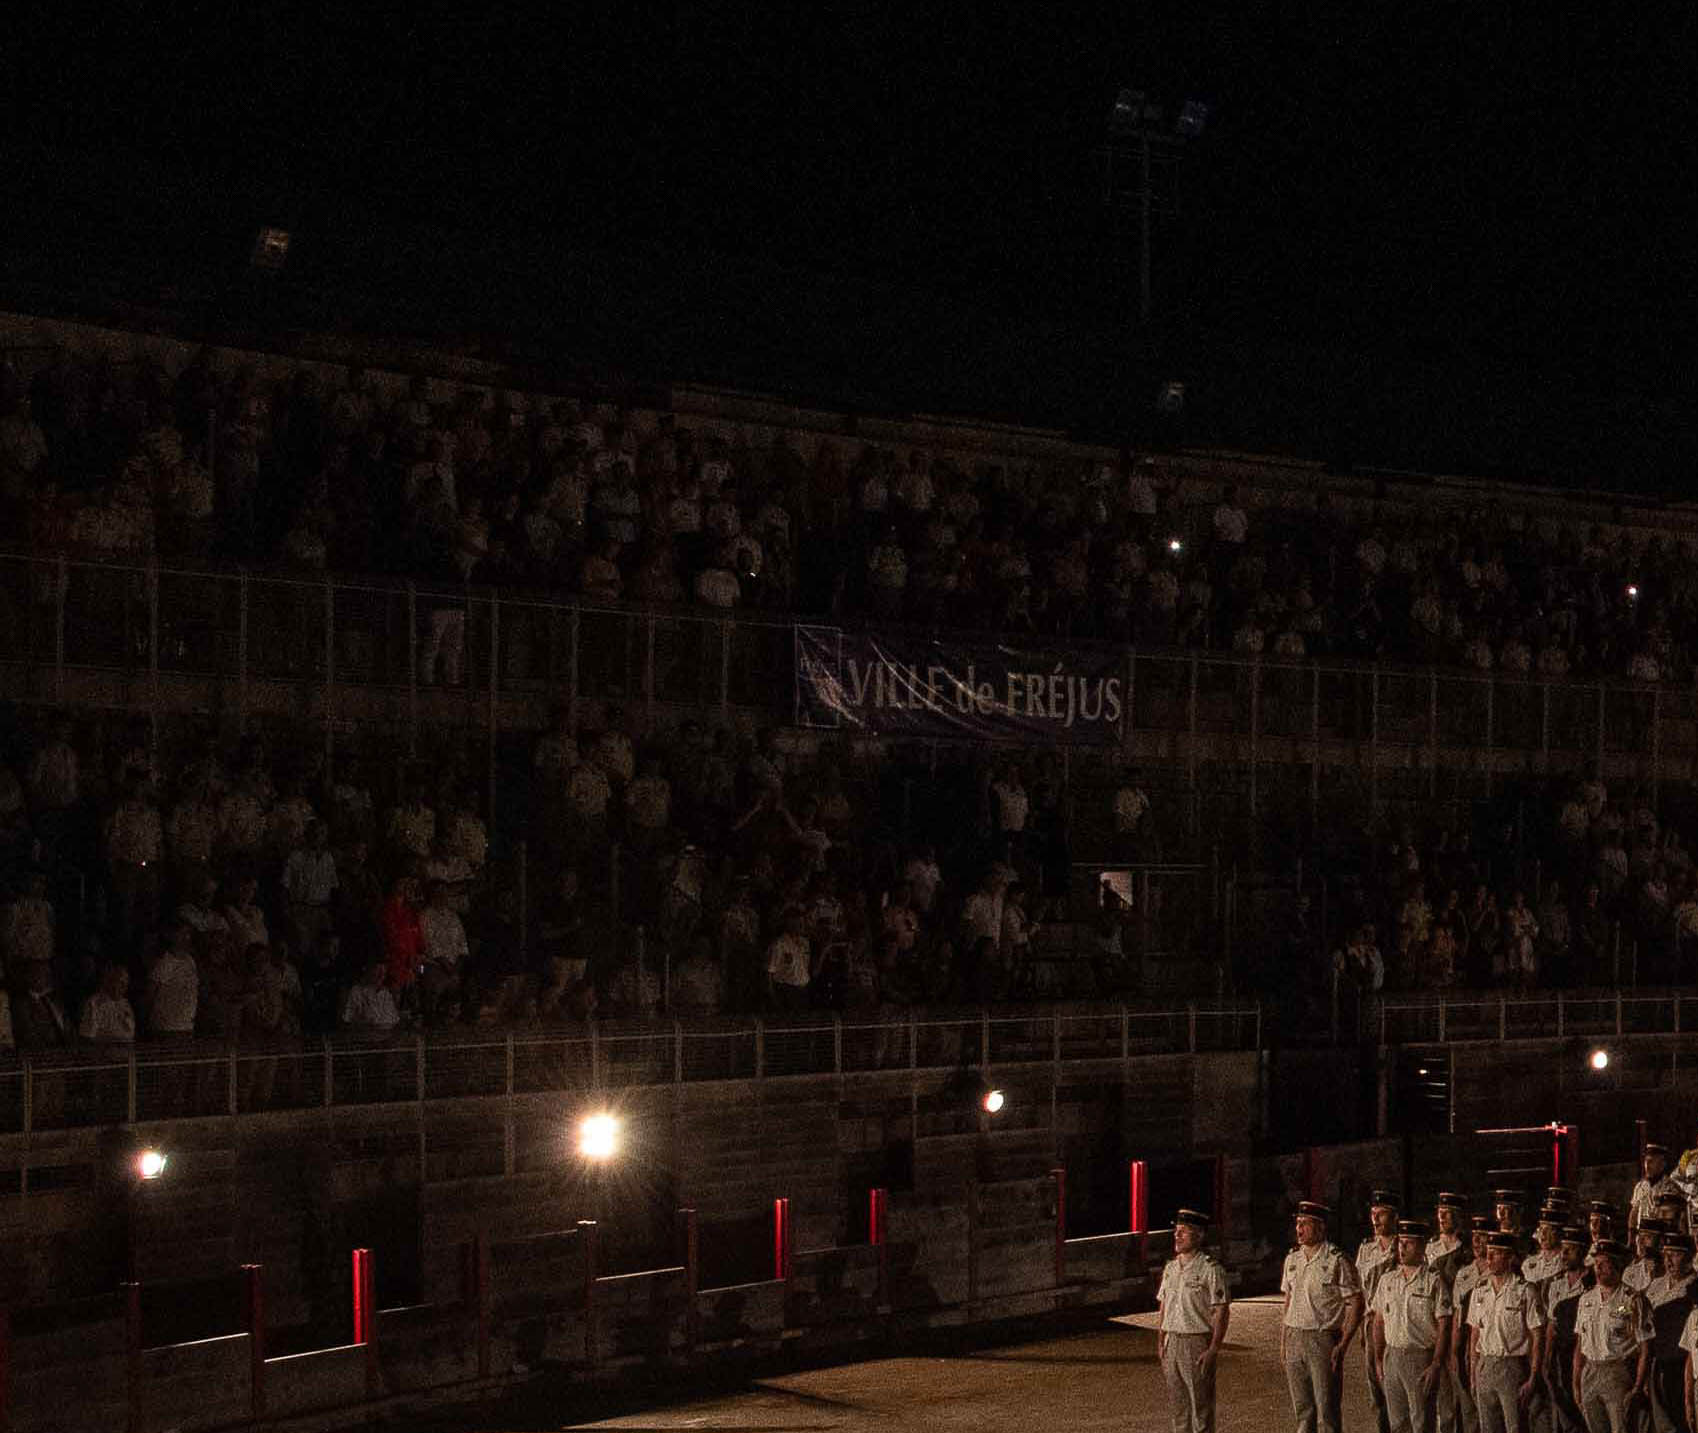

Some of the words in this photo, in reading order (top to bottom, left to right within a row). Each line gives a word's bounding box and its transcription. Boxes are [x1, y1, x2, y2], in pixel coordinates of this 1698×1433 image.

[848, 659, 945, 711] VILLE
[955, 664, 994, 715] de
[1007, 661, 1121, 728] FRÉJUS
